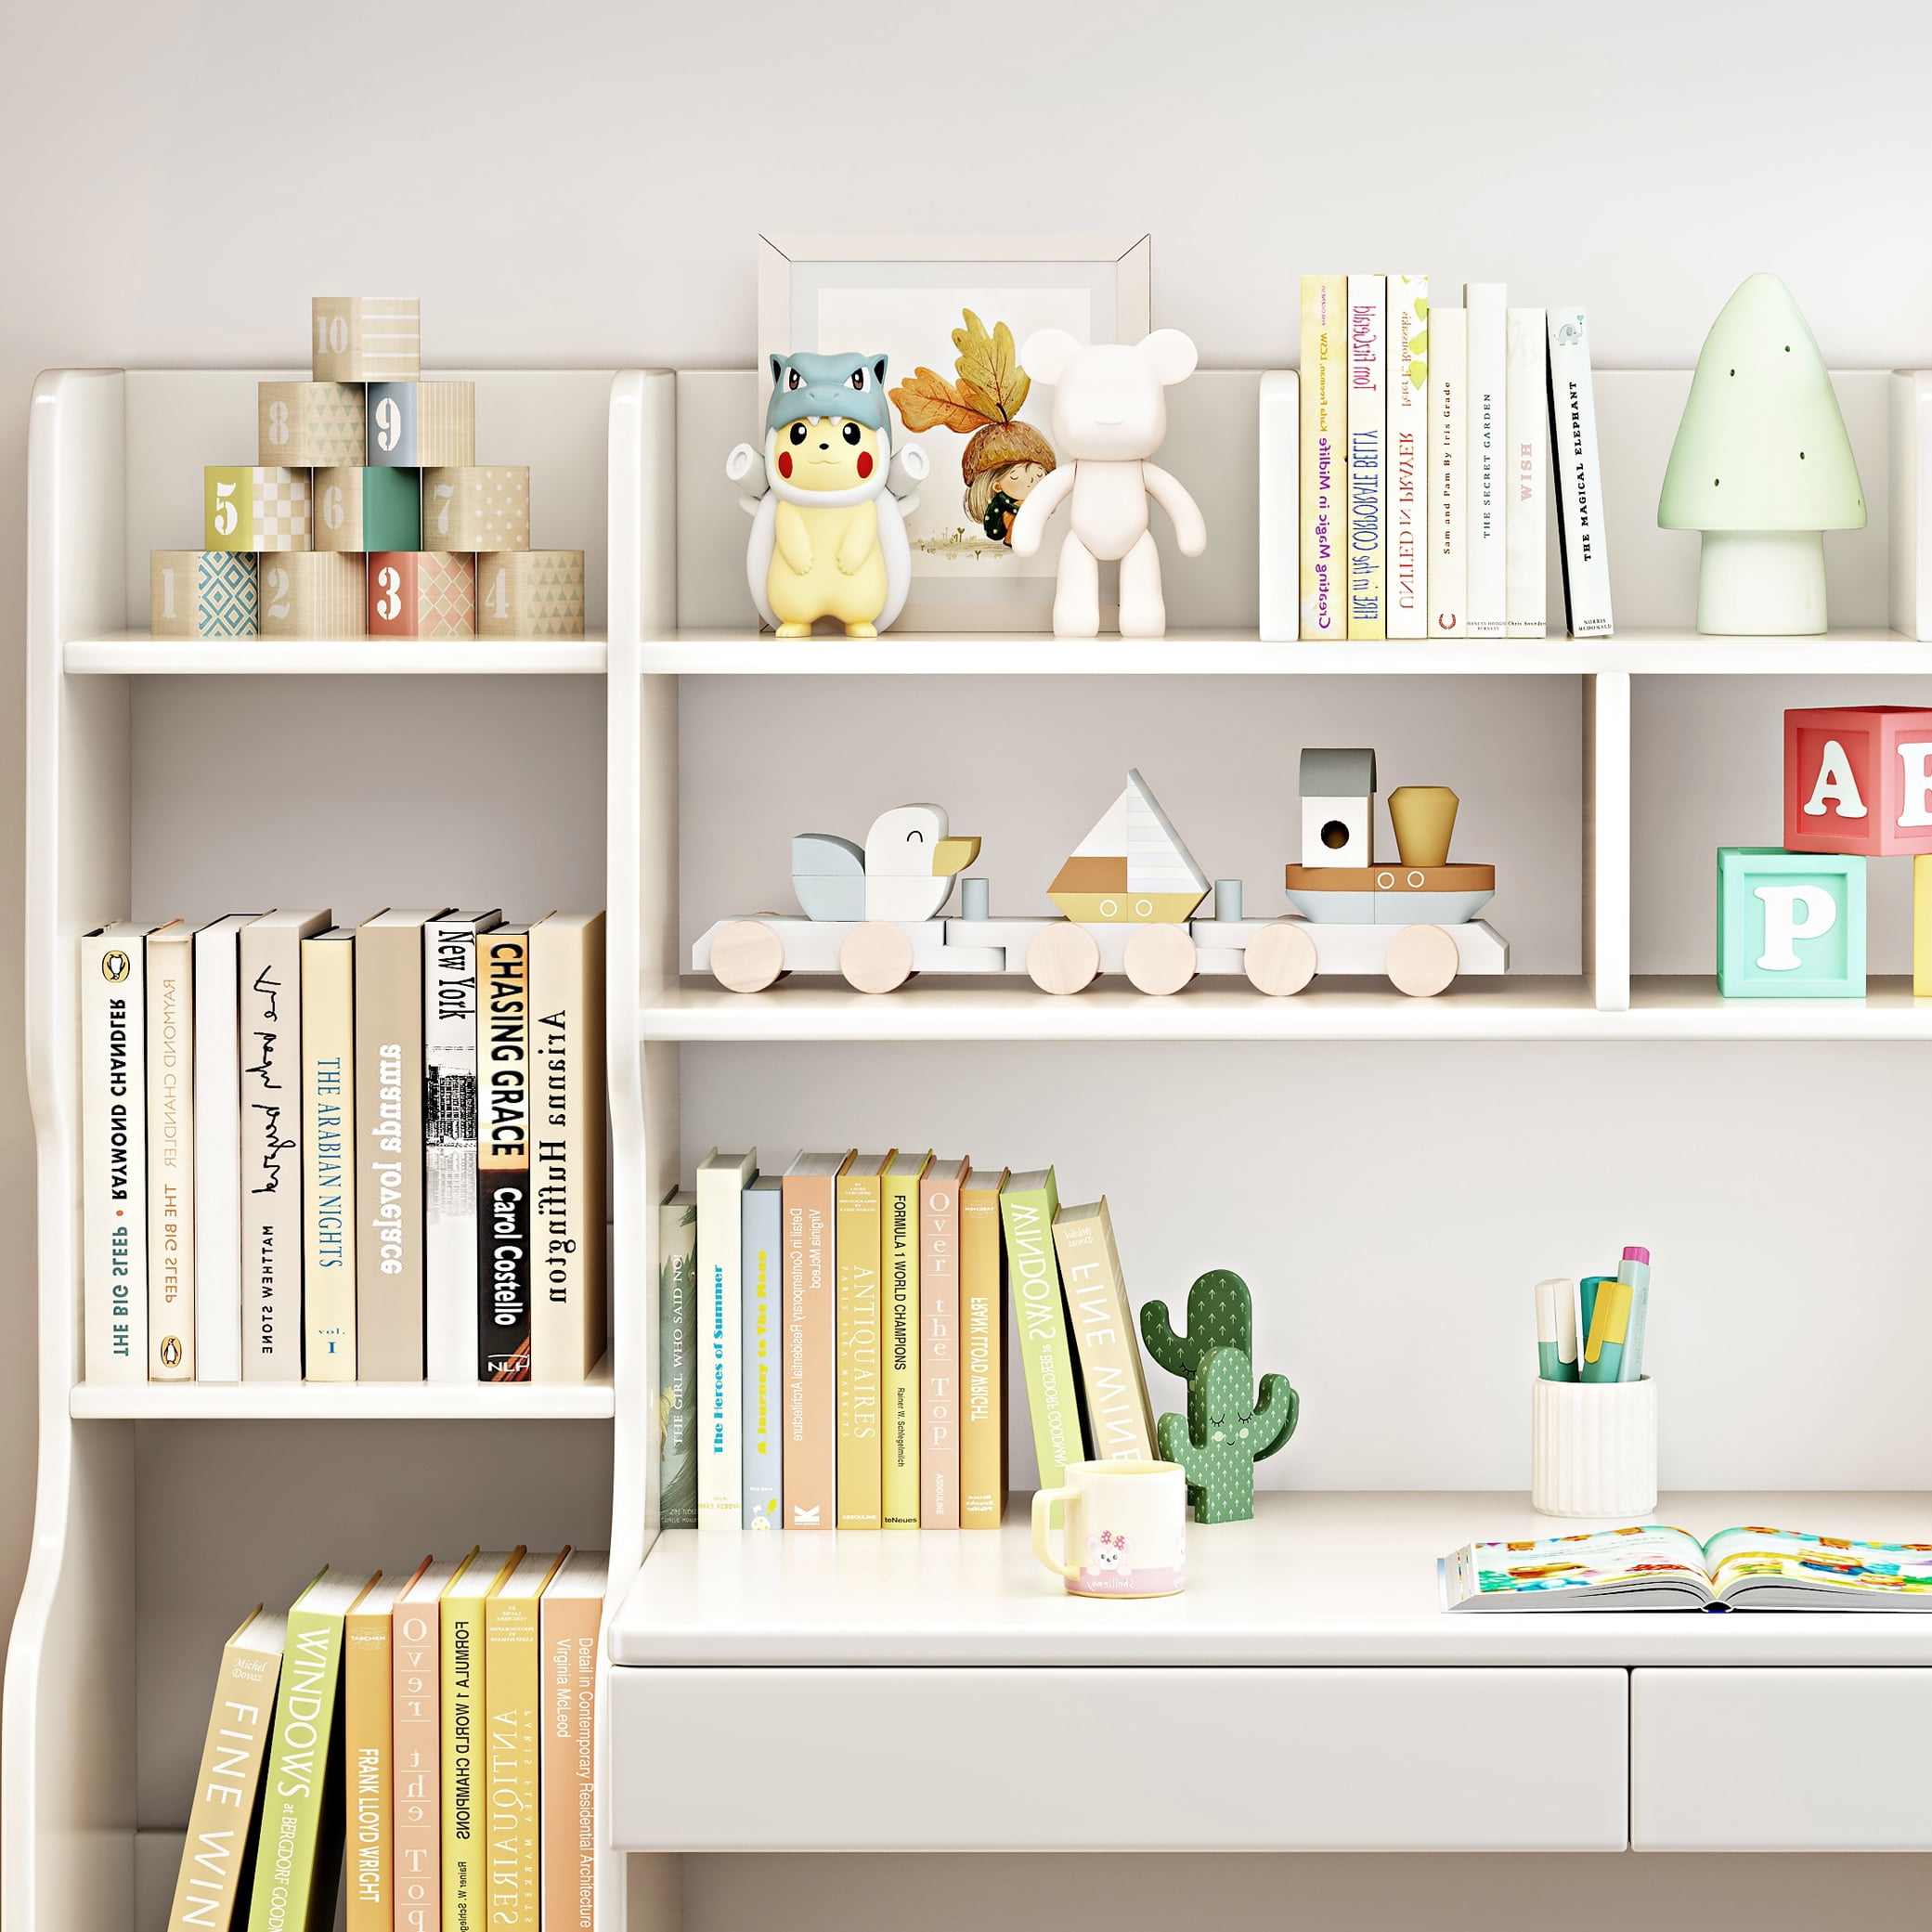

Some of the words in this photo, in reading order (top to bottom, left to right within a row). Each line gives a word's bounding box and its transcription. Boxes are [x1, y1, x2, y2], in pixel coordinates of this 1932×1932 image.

[317, 316, 349, 355] 10
[268, 400, 289, 446] 8
[375, 396, 401, 451] 9
[1569, 382, 1583, 455] ELEPHANT
[1444, 451, 1451, 466] By
[1521, 443, 1532, 501] WISH
[214, 482, 238, 536] 5
[323, 486, 344, 530] 6
[434, 484, 454, 535] 7
[1577, 462, 1588, 526] MAGICAL
[1583, 533, 1591, 562] THE
[162, 568, 176, 619] 1
[267, 567, 291, 619] 2
[377, 566, 402, 620] 3
[485, 568, 509, 620] 4
[1804, 740, 1867, 818] A
[437, 930, 475, 971] New
[1753, 885, 1836, 971] P
[437, 977, 475, 1020] York
[490, 943, 525, 1062] CHASING
[317, 1057, 343, 1096] THE
[490, 1070, 525, 1156] GRACE
[317, 1103, 343, 1187] ARABIAN
[317, 1195, 343, 1268] NIGHTS
[493, 1187, 525, 1239] Carol
[894, 1195, 906, 1249] FORMULA
[929, 1193, 950, 1272] Over
[493, 1245, 525, 1326] Costello
[673, 1254, 683, 1282] NO!
[757, 1251, 768, 1298] Moon
[894, 1261, 906, 1301] WORLD
[673, 1288, 683, 1323] SAID
[713, 1264, 723, 1339] Summer
[757, 1304, 768, 1335] The
[932, 1298, 947, 1356] the
[673, 1329, 683, 1368] WHO
[713, 1343, 723, 1358] of
[757, 1340, 768, 1357] to
[849, 1265, 875, 1438] ANTIQUAIRES
[894, 1304, 906, 1370] CHAMPIONS
[673, 1373, 683, 1409] GIRL
[713, 1363, 723, 1419] Heroes
[757, 1363, 768, 1434] Journey
[895, 1387, 906, 1409] Rainer
[673, 1415, 683, 1446] THE
[713, 1423, 723, 1455] The
[757, 1441, 768, 1455] A
[895, 1421, 906, 1468] Schlegelmilch
[234, 1658, 268, 1672] Michel
[553, 1639, 571, 1686] Virginia
[579, 1637, 594, 1674] Detail
[579, 1676, 594, 1688] in
[278, 1627, 331, 1798] WINDOWS
[557, 1690, 571, 1737] McLeod
[576, 1691, 594, 1779] Contemporary
[207, 1701, 259, 1808] FINE
[358, 1748, 380, 1796] FRANK
[283, 1803, 294, 1813] at
[358, 1799, 380, 1846] LLOYD
[579, 1783, 594, 1852] Residential
[275, 1817, 297, 1885] BERGDORF
[358, 1848, 380, 1903] WRIGHT
[182, 1831, 234, 1927] WIN
[579, 1855, 594, 1927] Architecture
